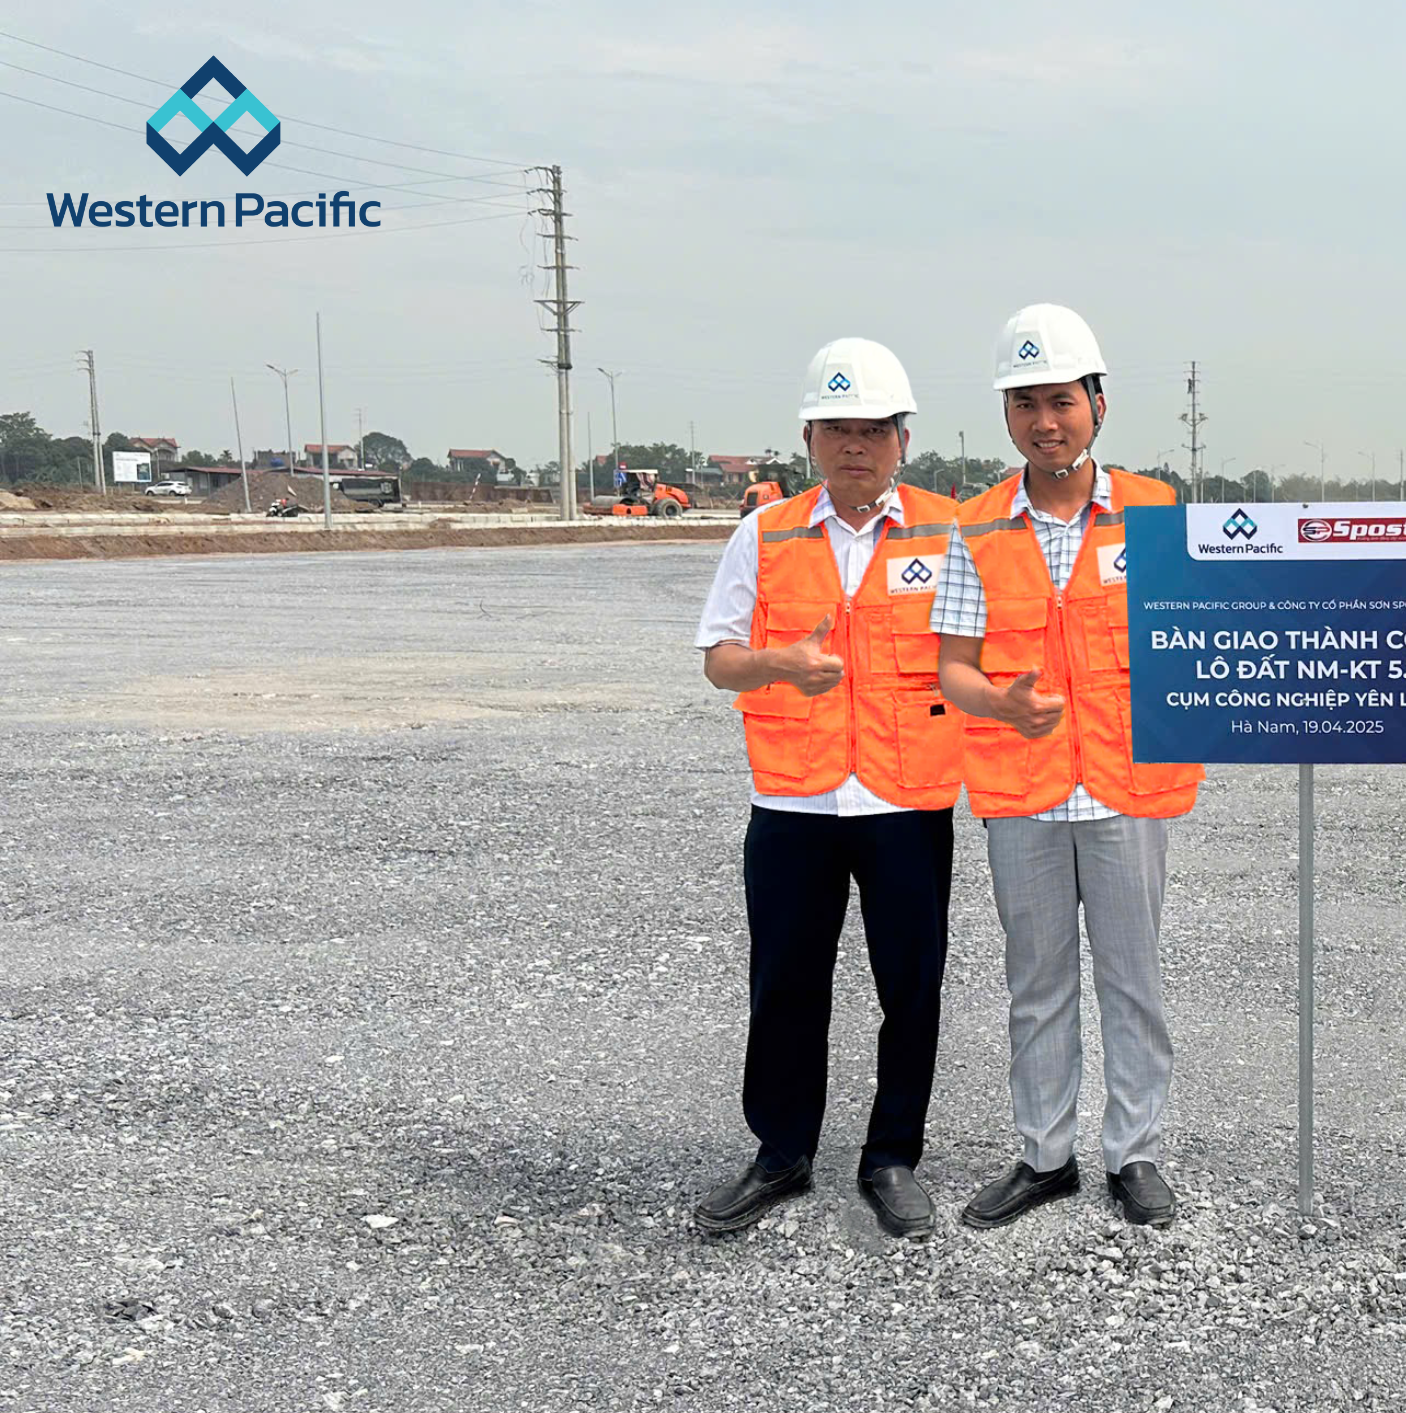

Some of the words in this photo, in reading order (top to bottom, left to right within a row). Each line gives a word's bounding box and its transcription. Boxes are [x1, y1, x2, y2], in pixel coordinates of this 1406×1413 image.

[1198, 543, 1245, 554] Western
[1245, 543, 1284, 554] Pacific
[1143, 601, 1190, 610] WESTERN
[1193, 601, 1230, 610] PACIFIC
[1231, 601, 1267, 610] GROUP
[1268, 601, 1276, 610] &
[1277, 599, 1307, 610] CÔNG
[1308, 601, 1321, 610] TY
[1369, 600, 1391, 610] SƠN
[1151, 626, 1206, 650] BÀN
[1213, 630, 1279, 650] GIAO
[1285, 625, 1378, 650] THÀNH
[1196, 655, 1230, 680] LÔ
[1236, 653, 1290, 680] ĐẤT
[1297, 660, 1382, 680] NM-KT
[1166, 692, 1210, 711] CỤM
[1215, 689, 1271, 707] CÔNG
[1276, 689, 1351, 711] NGHIỆP
[1355, 689, 1394, 707] YÊN
[1231, 720, 1253, 734] Hà
[1258, 720, 1300, 736] Nam,
[1302, 720, 1385, 734] 19.04.2025
